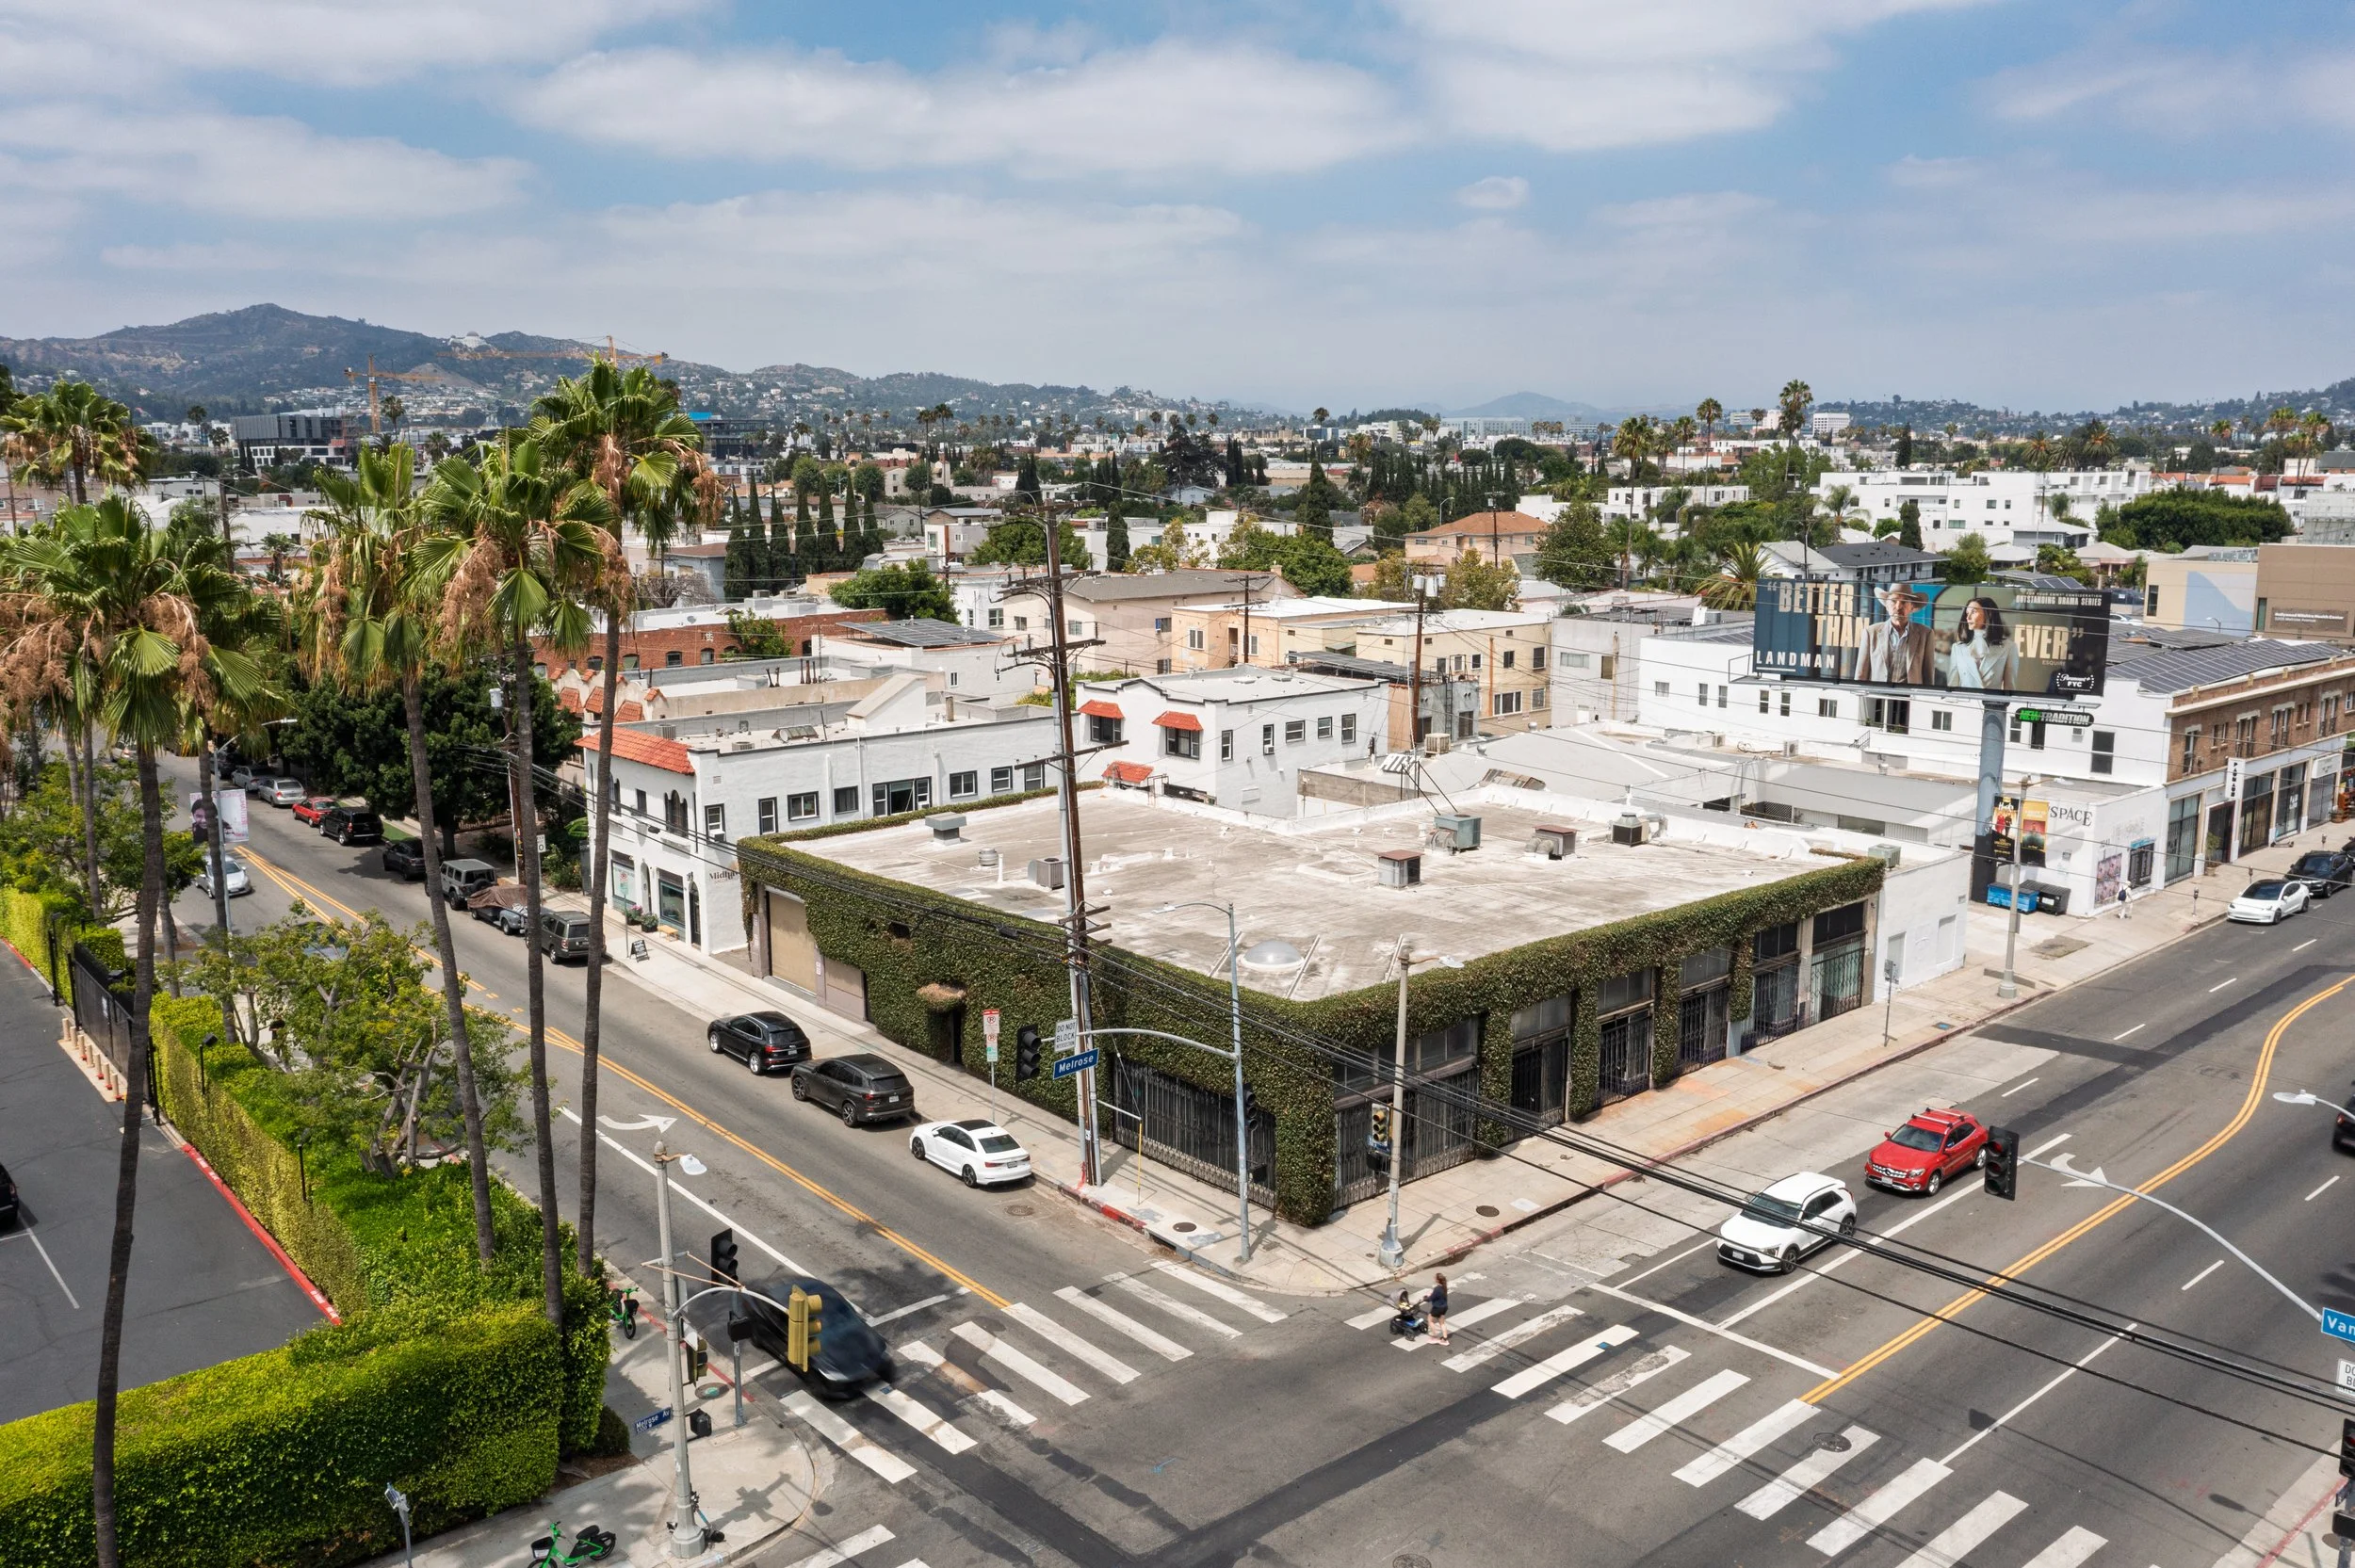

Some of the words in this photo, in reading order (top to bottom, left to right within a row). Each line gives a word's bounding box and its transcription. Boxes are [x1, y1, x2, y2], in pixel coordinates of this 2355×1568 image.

[2016, 594, 2055, 605] OUTSTANDING
[2057, 596, 2079, 606] DRAMA
[2081, 597, 2103, 606] SERIES
[1814, 614, 1871, 648] THAN
[1756, 650, 1835, 669] LANDMAN
[2040, 712, 2090, 725] TRADITION
[1056, 1024, 1065, 1033] DO
[1065, 1022, 1076, 1031] NOT
[1056, 1032, 1075, 1043] BLOCK
[1059, 1054, 1094, 1074] Melrose
[2327, 1315, 2355, 1335] Van
[636, 1415, 658, 1429] Melrose
